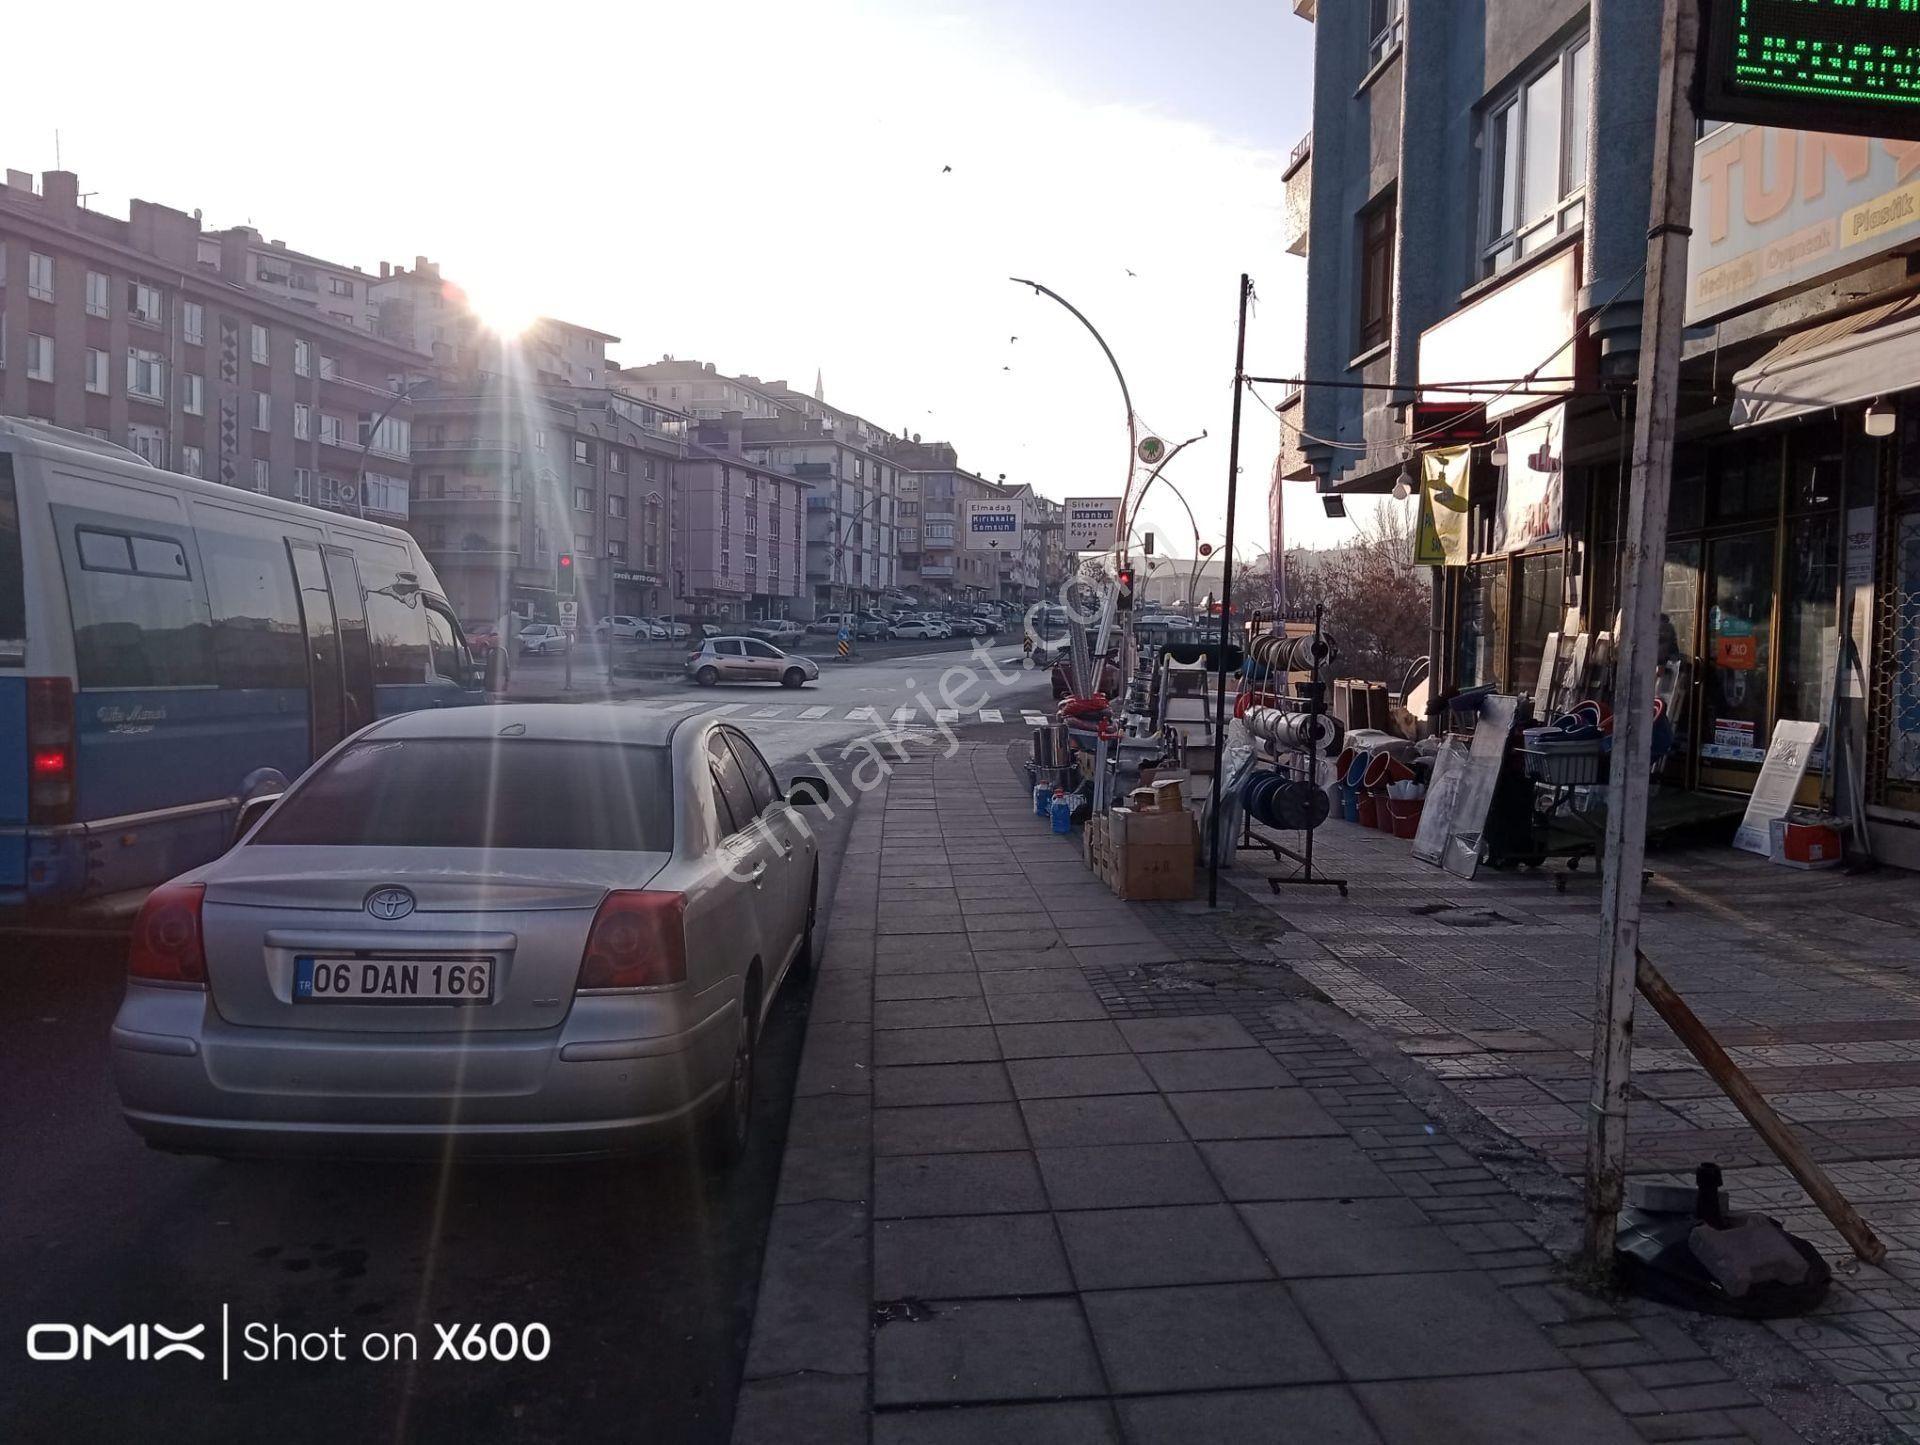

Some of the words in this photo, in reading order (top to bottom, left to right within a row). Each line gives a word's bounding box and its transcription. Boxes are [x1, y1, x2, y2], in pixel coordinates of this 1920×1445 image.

[1700, 126, 1920, 245] TUN
[1852, 192, 1914, 236] Plastik
[971, 504, 1011, 512] Elmadağ
[299, 980, 311, 990] TR
[314, 963, 351, 993] 06
[360, 964, 419, 995] DAN
[432, 965, 487, 995] 166
